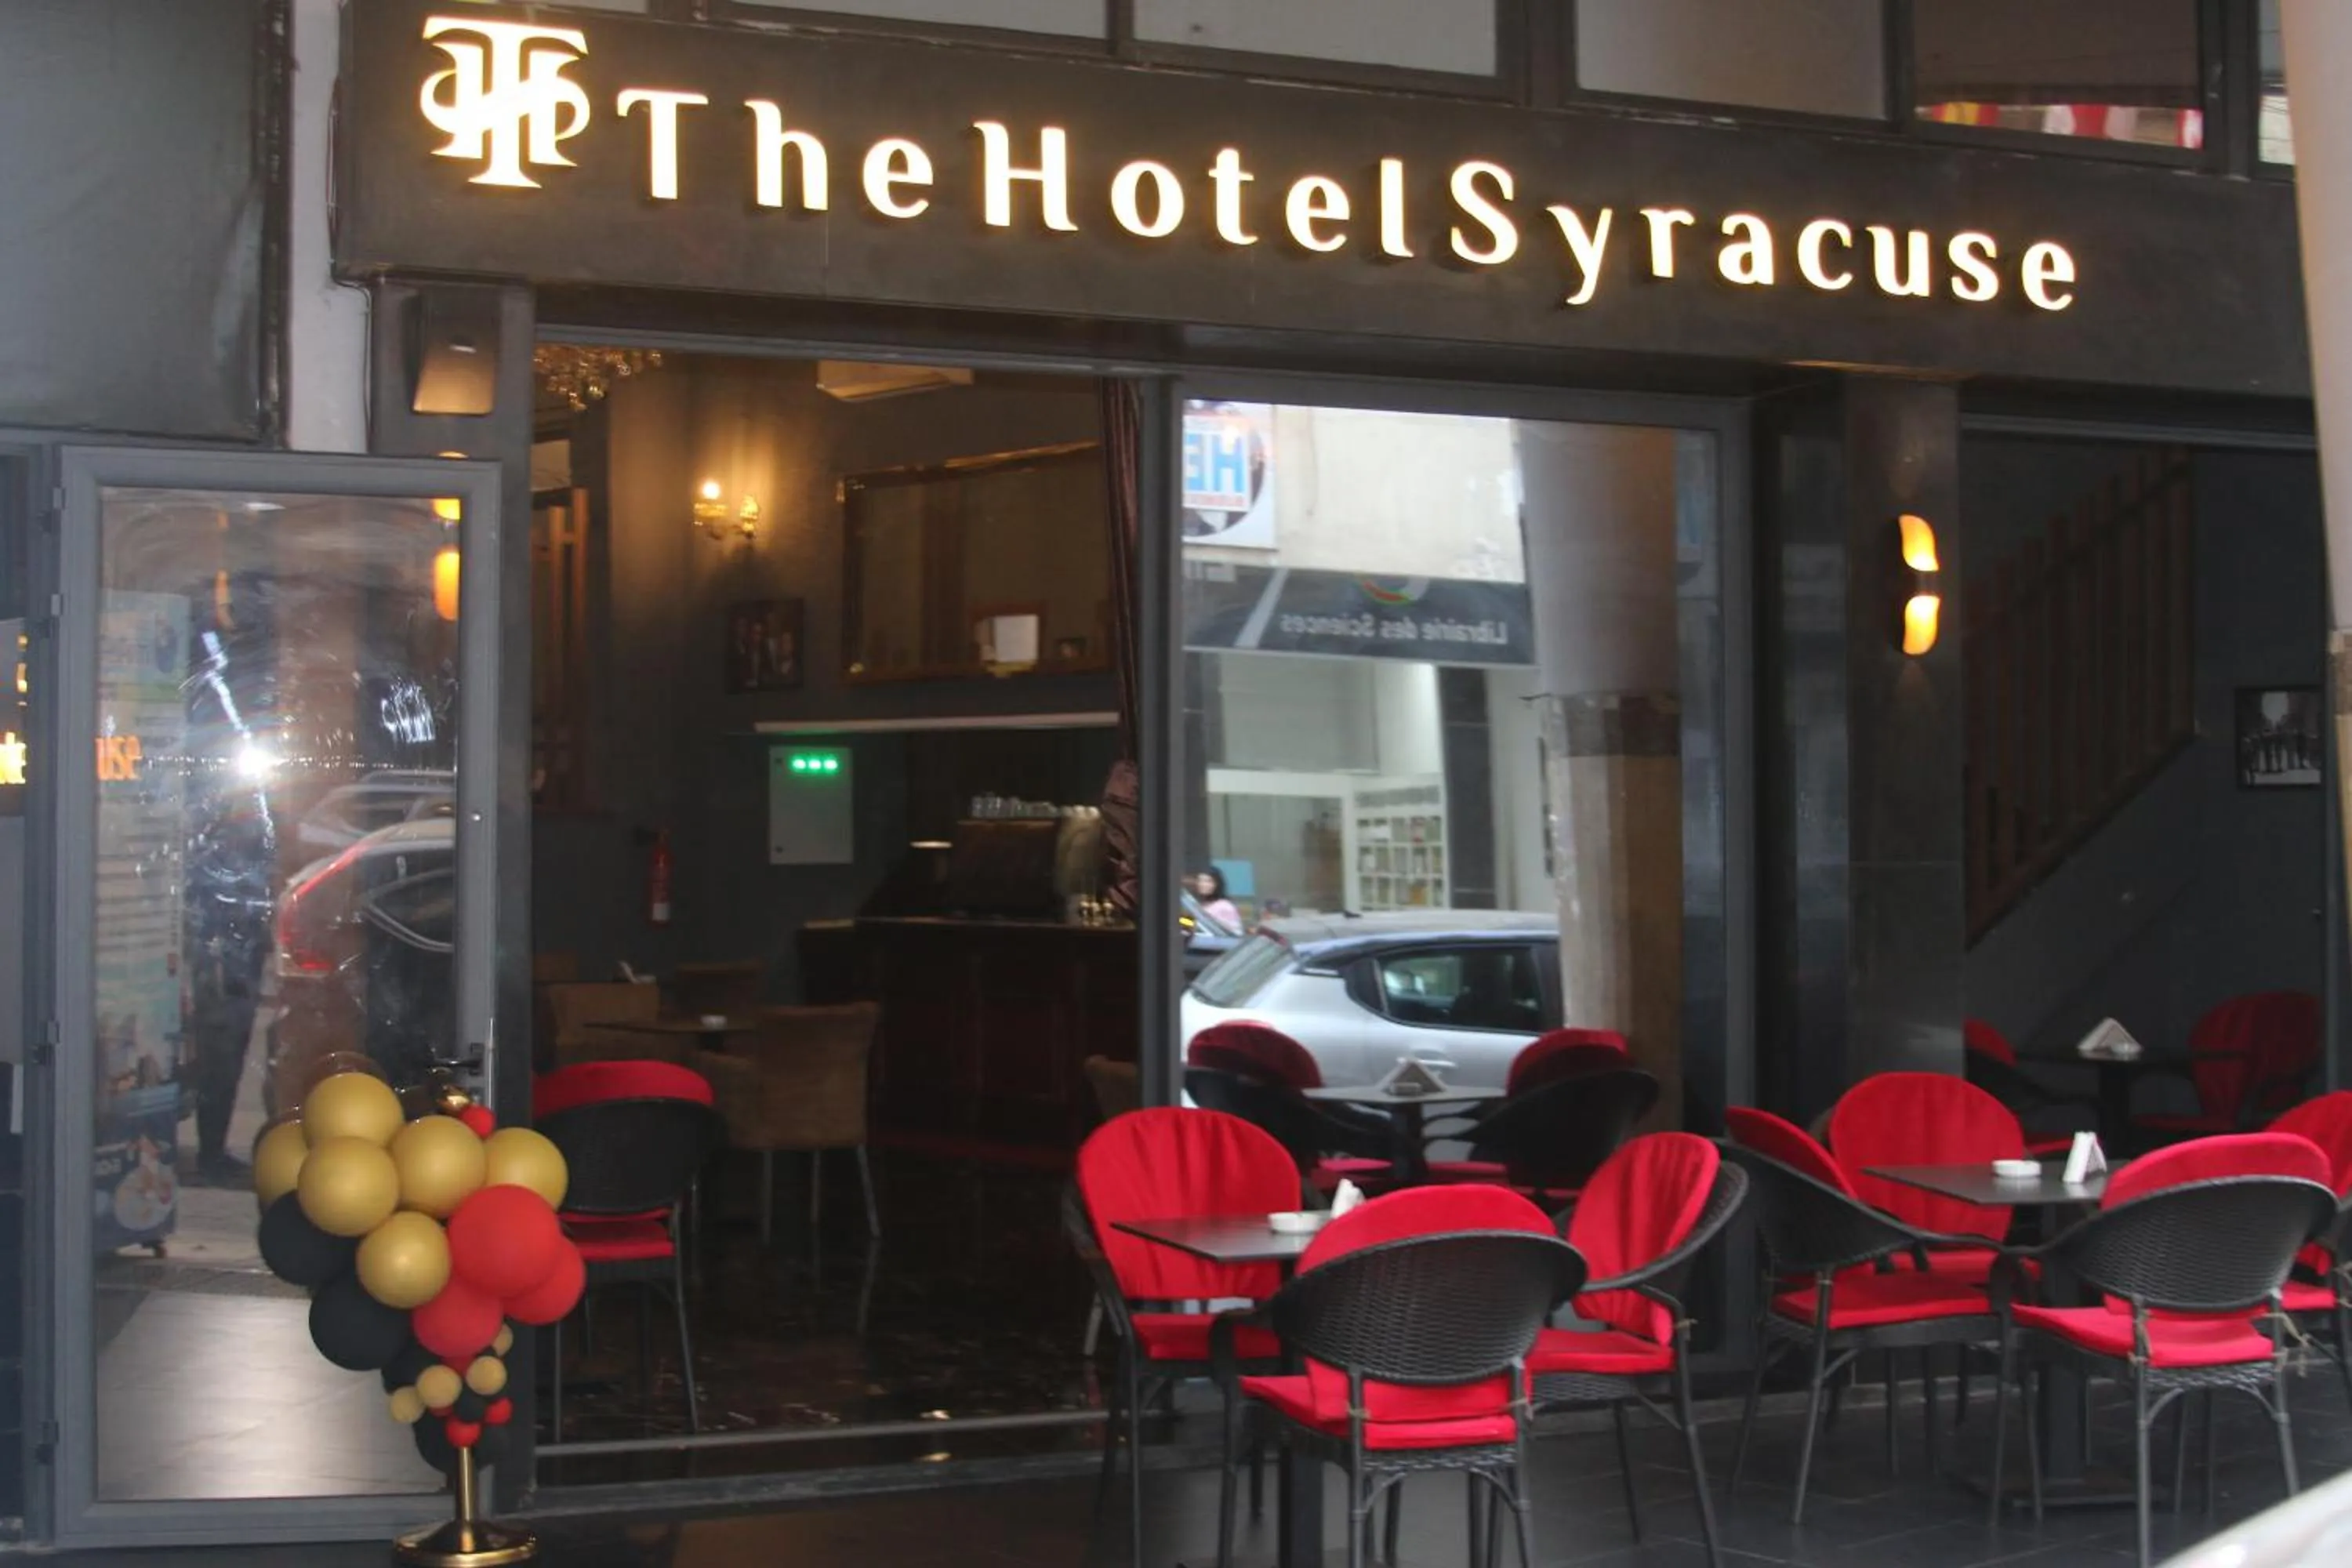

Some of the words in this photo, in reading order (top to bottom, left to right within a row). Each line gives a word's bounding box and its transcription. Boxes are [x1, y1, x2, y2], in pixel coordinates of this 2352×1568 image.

[616, 88, 934, 220] The
[972, 121, 1414, 259] Hotel
[1448, 158, 2076, 310] Syracuse
